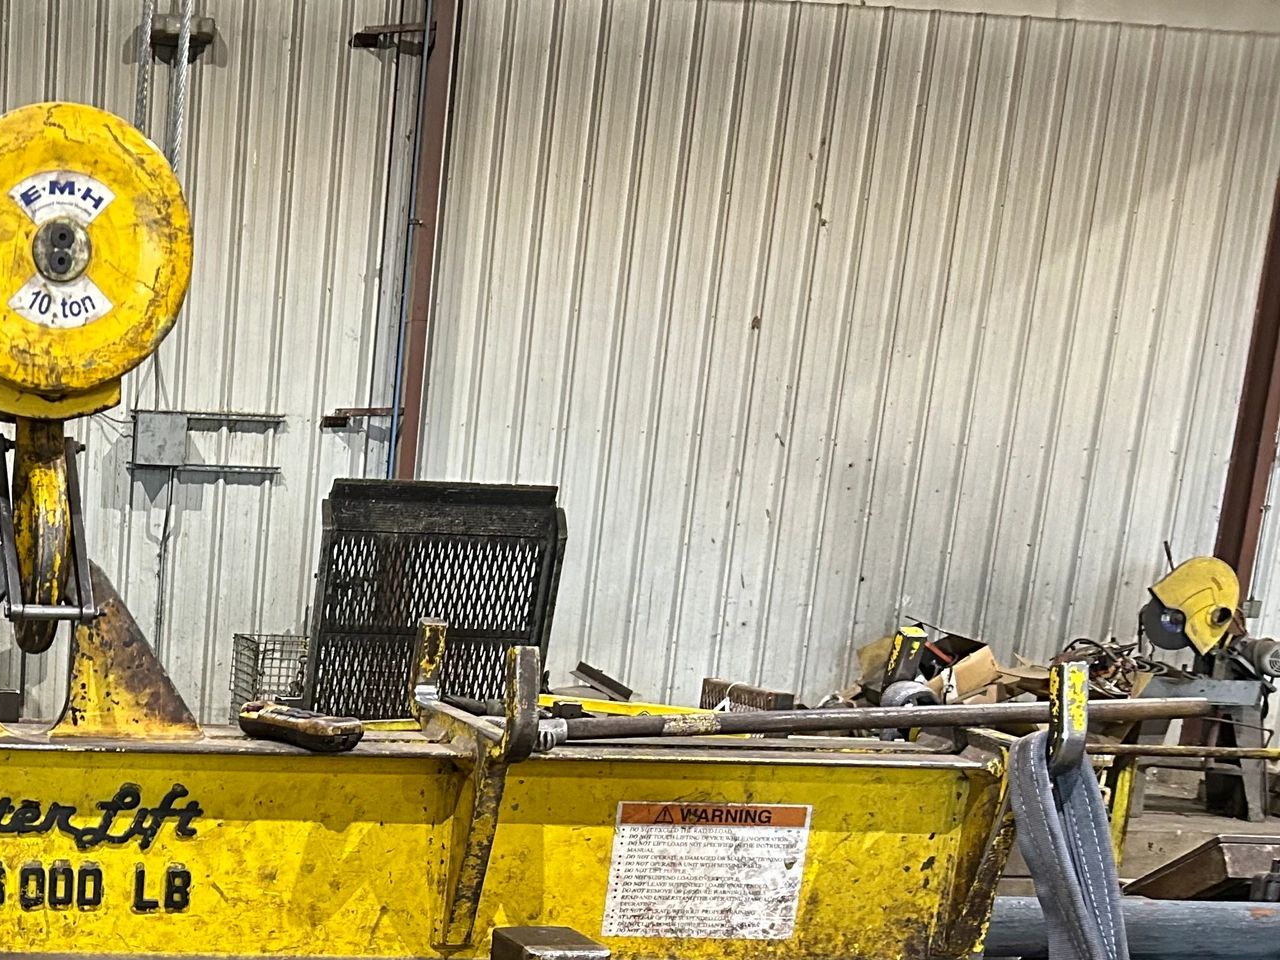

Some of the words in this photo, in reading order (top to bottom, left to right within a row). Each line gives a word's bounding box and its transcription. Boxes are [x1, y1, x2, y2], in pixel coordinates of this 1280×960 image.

[29, 290, 52, 315] 10
[60, 295, 96, 318] ton
[74, 782, 203, 851] Lift
[680, 807, 773, 825] WARNING
[129, 861, 193, 914] LB
